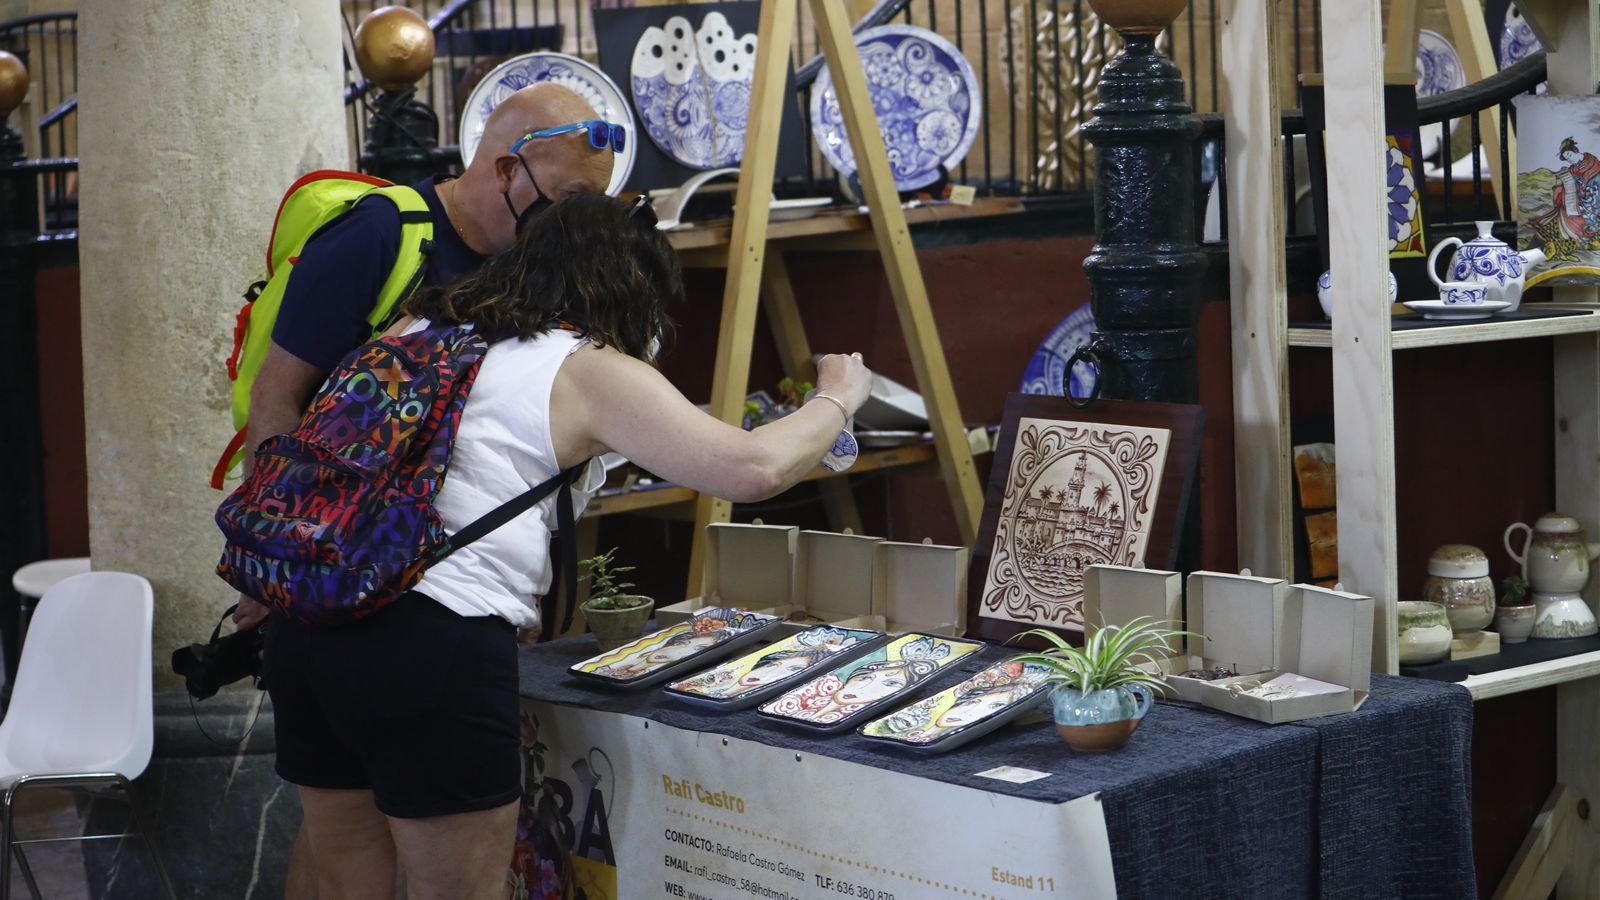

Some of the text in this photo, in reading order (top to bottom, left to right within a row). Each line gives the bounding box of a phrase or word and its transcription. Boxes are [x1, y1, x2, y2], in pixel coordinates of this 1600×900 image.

[662, 773, 745, 814] Rafi Castro
[526, 774, 617, 868] BA
[664, 828, 715, 853] CONTACTO:
[716, 843, 748, 863] Rafaela
[748, 853, 776, 872] Castro
[664, 855, 800, 900] EMAIL: rafi_castro_58@hotmail
[664, 881, 686, 899] WEB:
[815, 874, 835, 891] TLF:
[836, 880, 855, 896] 636
[856, 885, 875, 900] 380
[991, 866, 1055, 892] Estand 11
